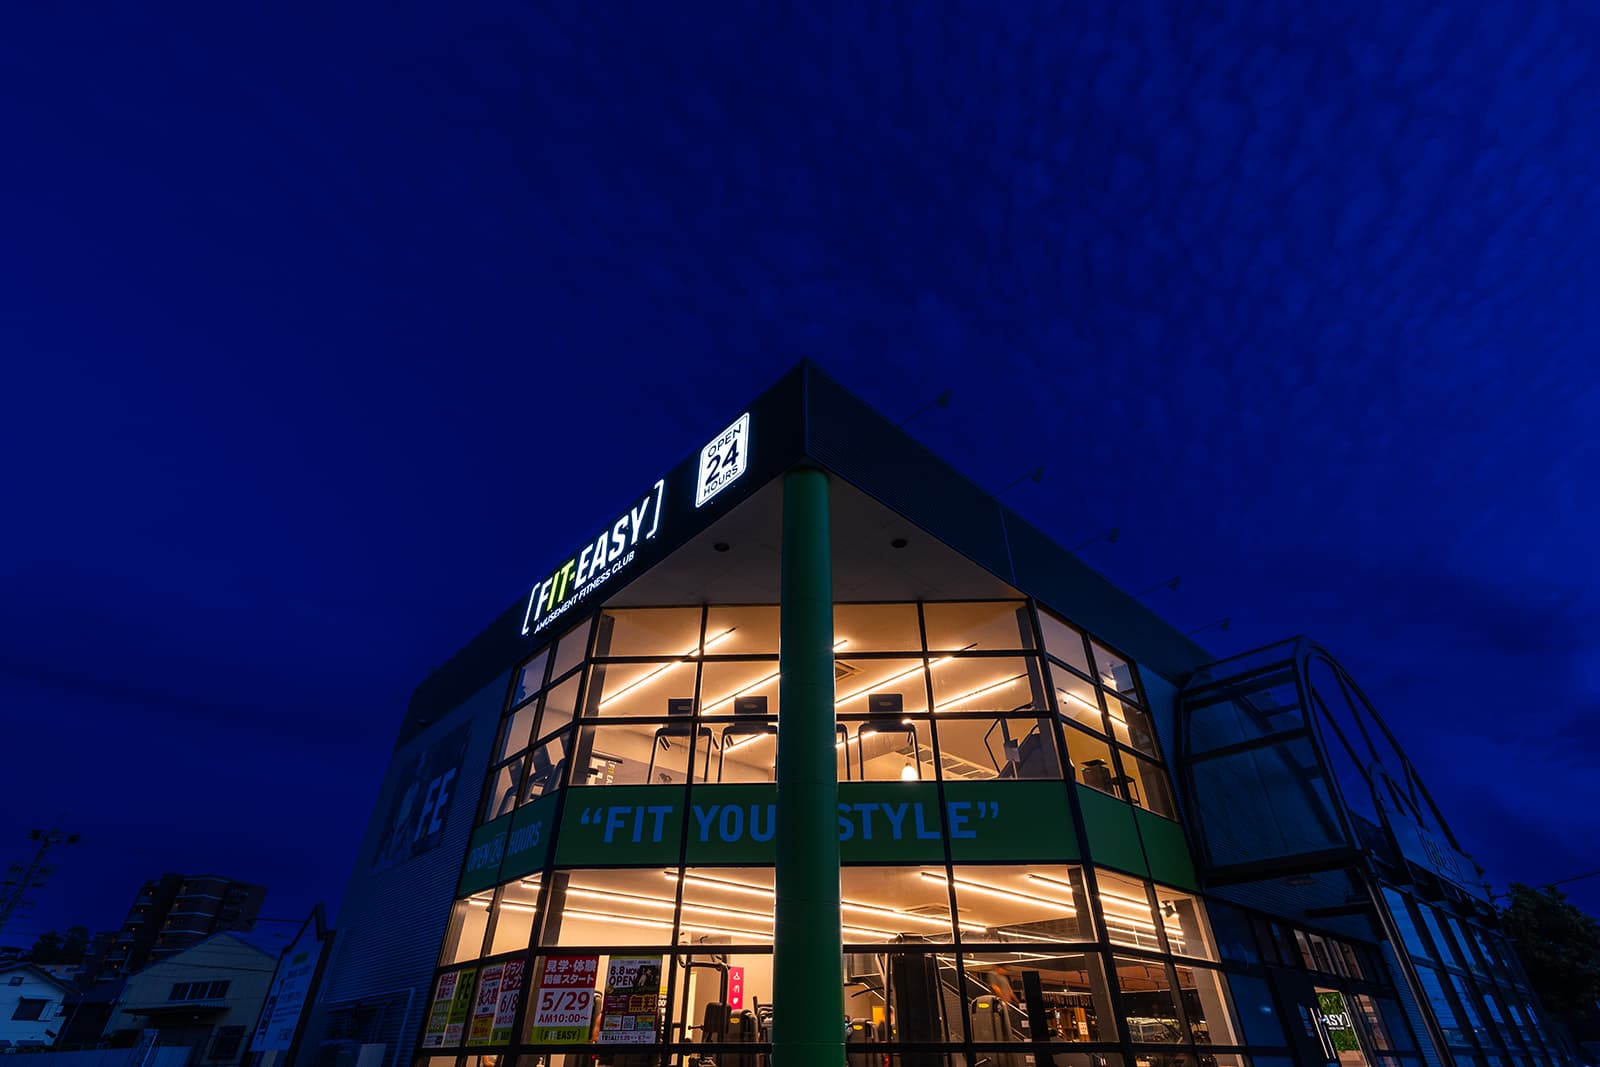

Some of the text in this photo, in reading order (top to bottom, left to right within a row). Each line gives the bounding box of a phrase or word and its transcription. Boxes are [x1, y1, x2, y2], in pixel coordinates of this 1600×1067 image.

[706, 422, 742, 459] OPEN
[704, 439, 740, 486] 24
[702, 464, 739, 498] HOURS
[533, 550, 635, 634] AMUSEMENT FITNESS CLUB
[507, 820, 543, 855] HOURS
[608, 975, 636, 987] OPEN
[500, 993, 519, 1014] 6/8
[541, 991, 590, 1012] 5/29
[628, 993, 658, 1013] 無料
